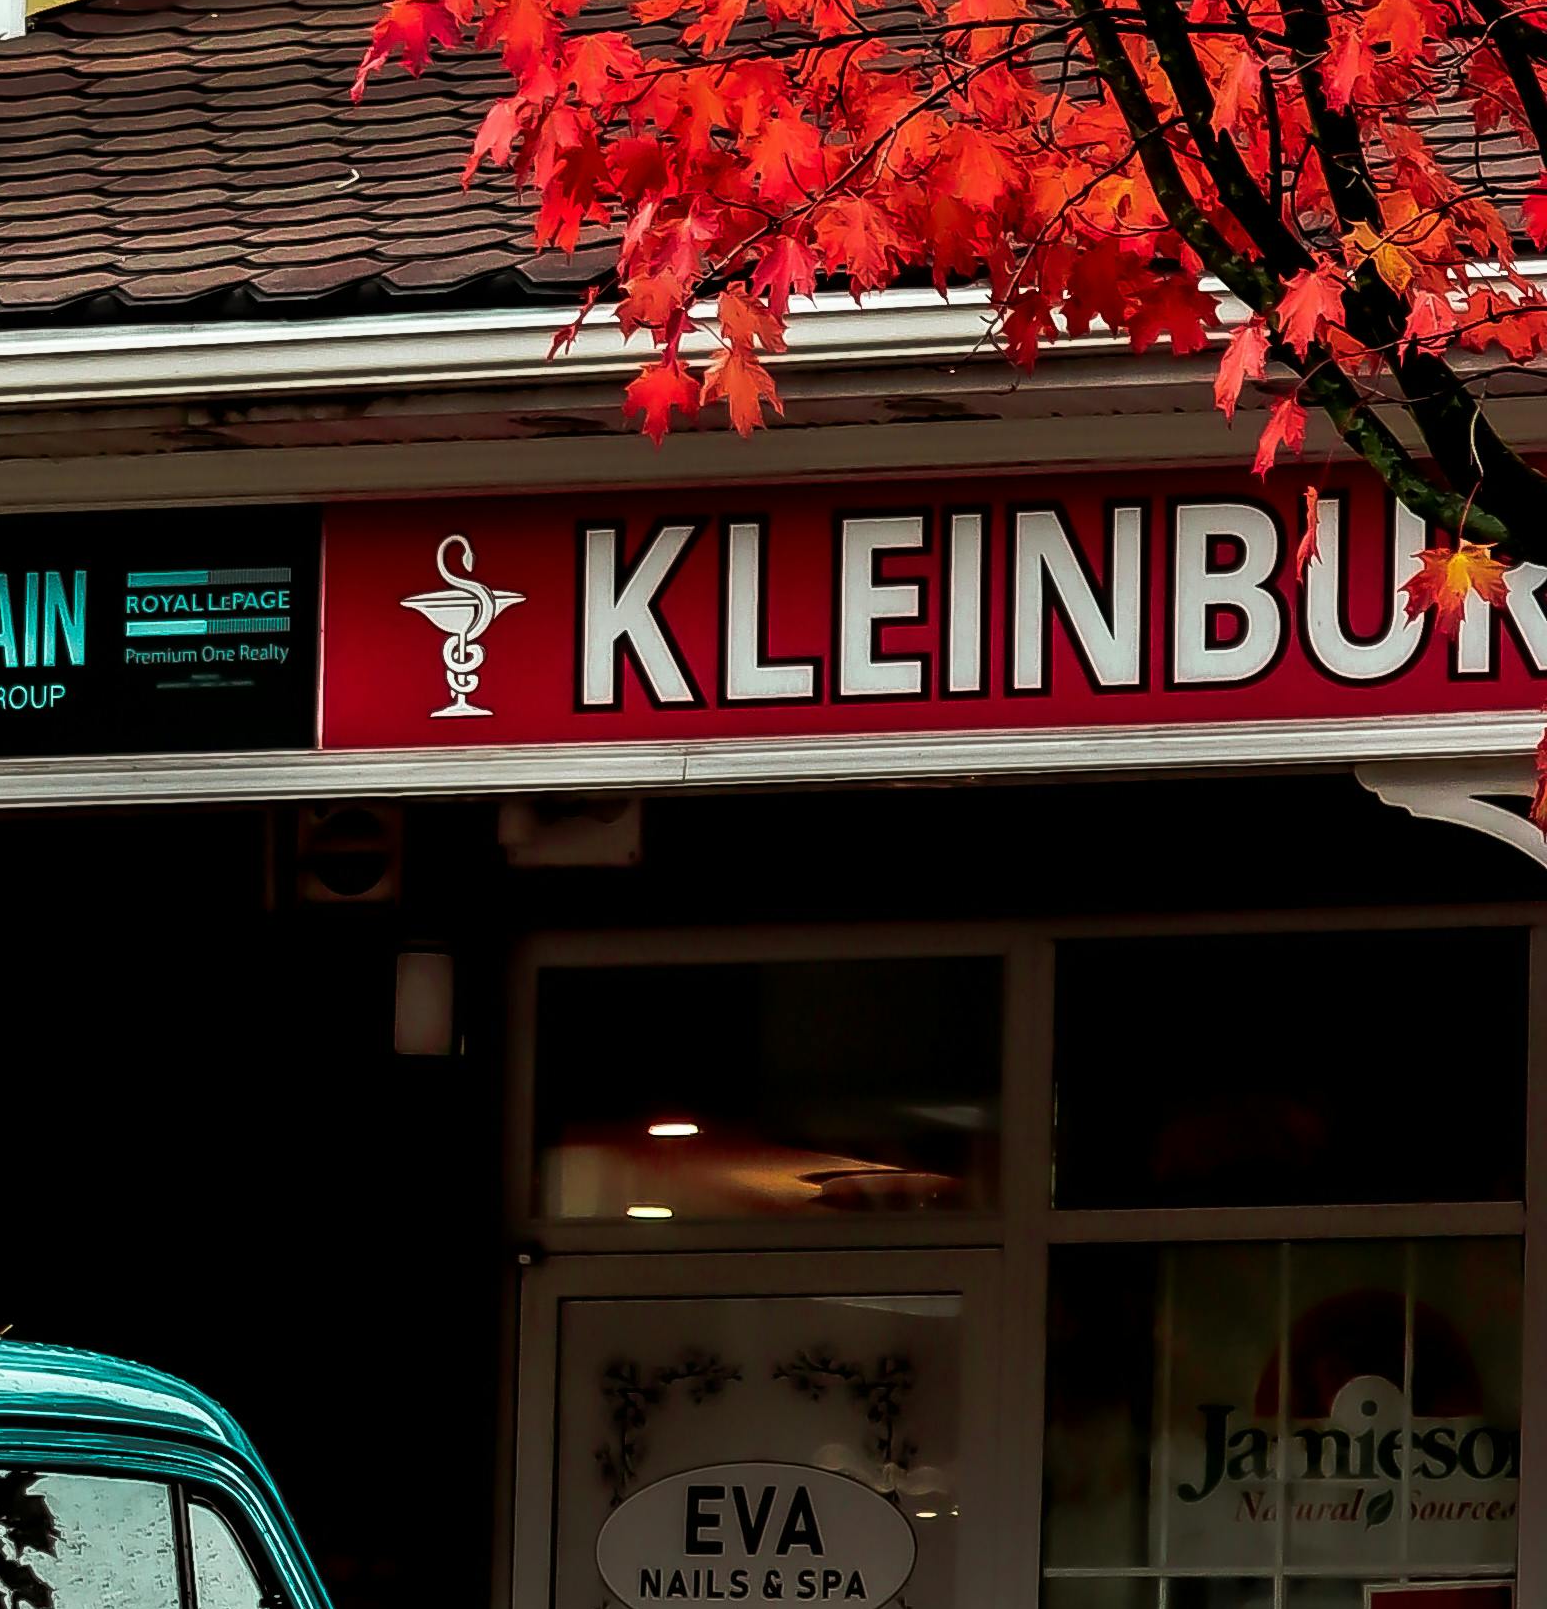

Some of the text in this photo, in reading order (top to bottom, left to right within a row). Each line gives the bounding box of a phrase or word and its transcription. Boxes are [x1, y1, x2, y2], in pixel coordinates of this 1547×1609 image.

[126, 593, 204, 614] ROYAL
[124, 643, 291, 665] Premium One Realty
[684, 1485, 826, 1556] EVA
[639, 1569, 868, 1599] NAILS & SPA
